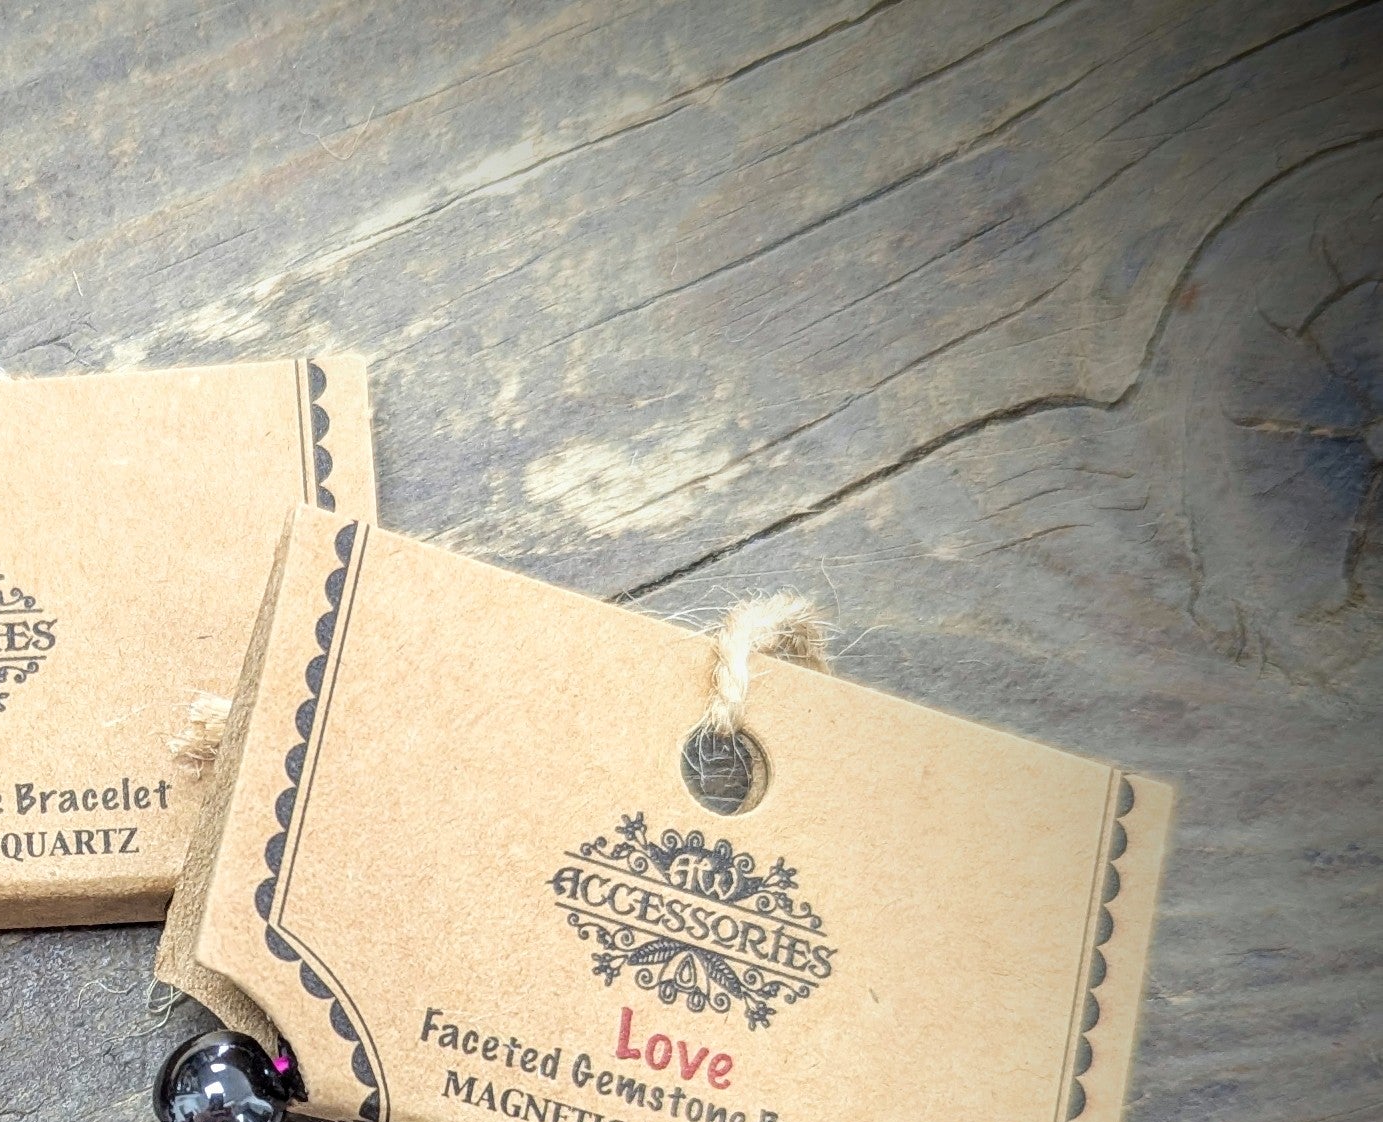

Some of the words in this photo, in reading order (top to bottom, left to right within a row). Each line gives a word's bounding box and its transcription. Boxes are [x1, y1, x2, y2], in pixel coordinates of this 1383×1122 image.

[15, 778, 171, 815] Bracelet
[1, 828, 139, 860] QUARTZ
[546, 866, 839, 979] ACCESSORIES
[420, 1007, 561, 1081] Faceted
[616, 1007, 734, 1090] Love
